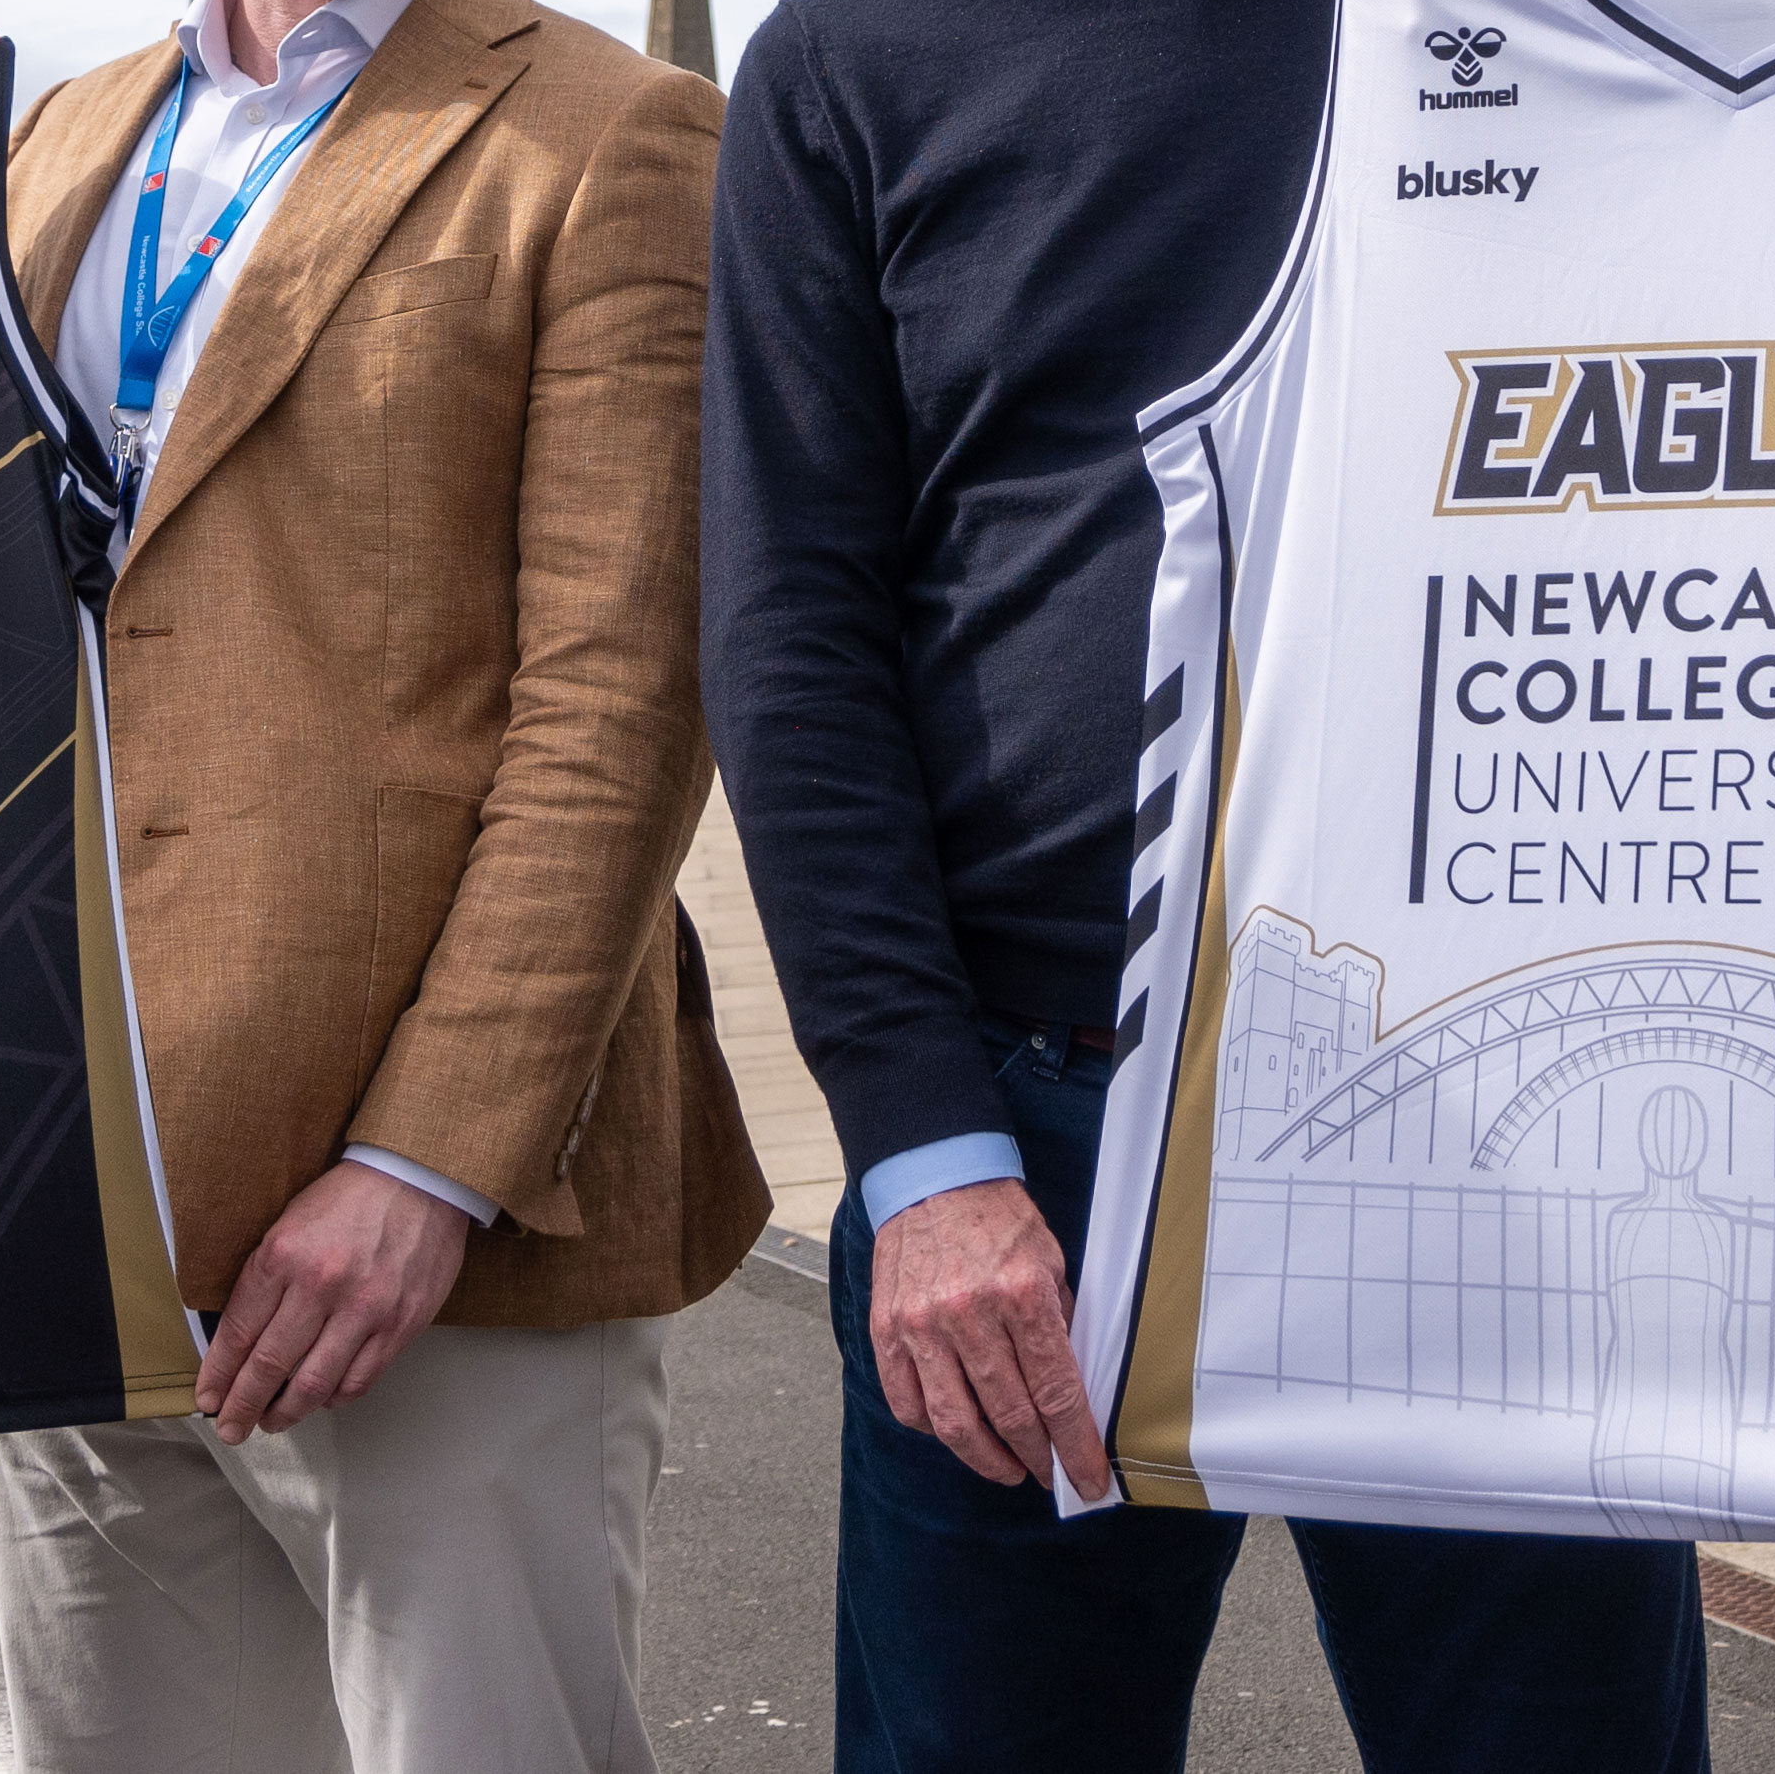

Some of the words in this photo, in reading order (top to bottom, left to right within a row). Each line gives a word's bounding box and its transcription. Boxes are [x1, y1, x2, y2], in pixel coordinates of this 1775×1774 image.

[1419, 82, 1519, 112] hummel
[1396, 158, 1541, 203] blusky
[1445, 840, 1765, 907] CENTRE
